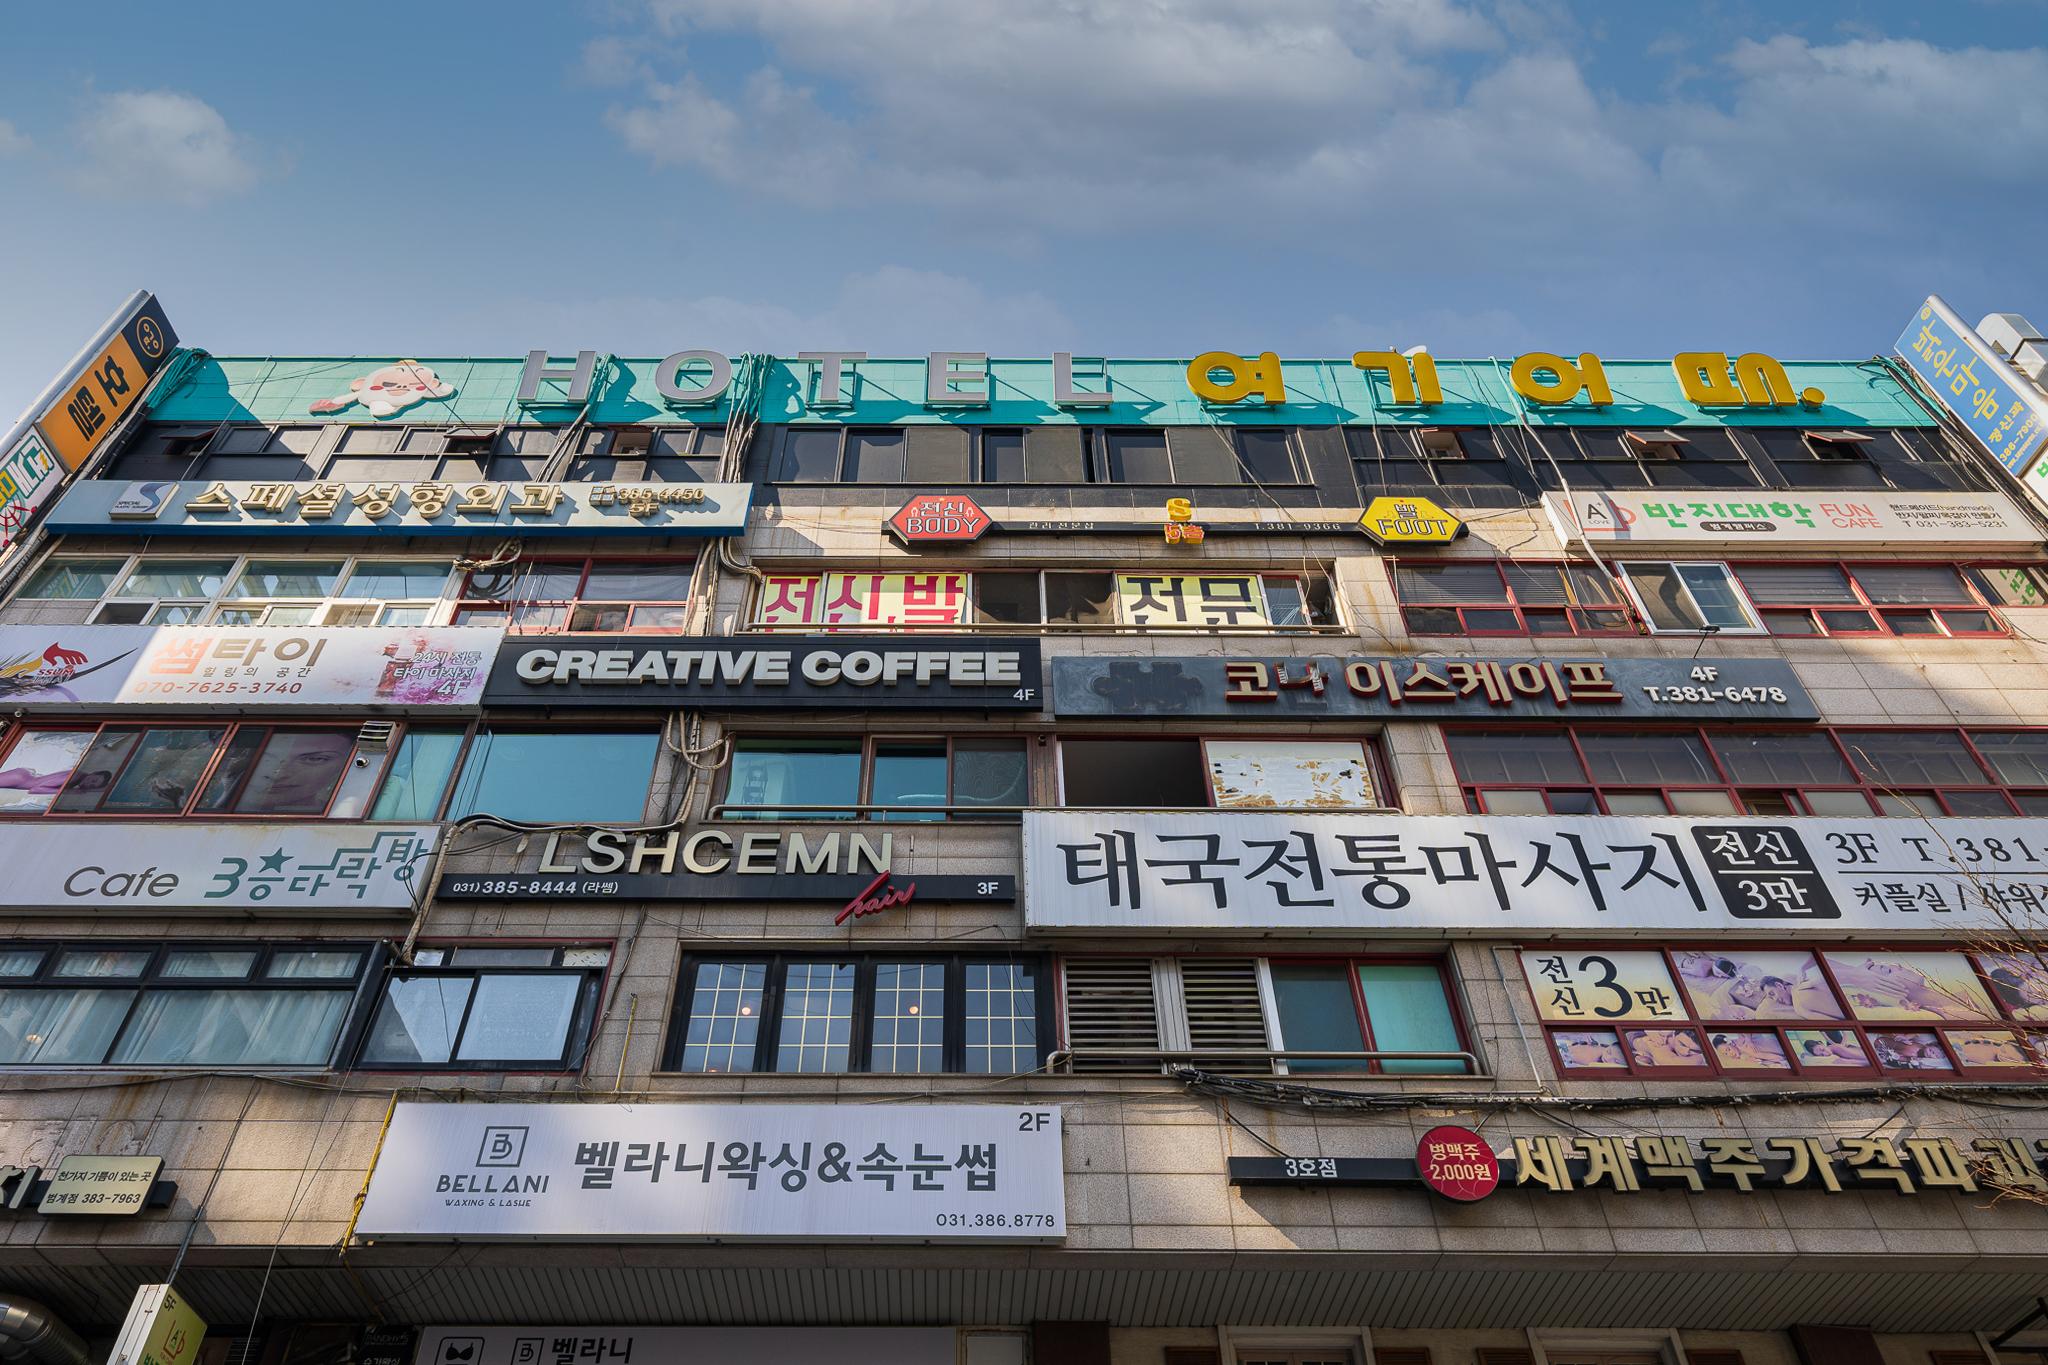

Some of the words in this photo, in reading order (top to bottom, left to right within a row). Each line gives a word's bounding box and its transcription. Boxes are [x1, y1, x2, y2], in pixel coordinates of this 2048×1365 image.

[517, 350, 1114, 404] HOTEL
[67, 355, 130, 442] 호텔
[185, 482, 564, 518] 스페셜성형외과
[919, 501, 966, 517] 전신
[629, 502, 660, 517] 5F
[1394, 504, 1418, 519] 발
[1642, 502, 1816, 528] 반지대학
[1819, 504, 1874, 517] FUN
[906, 517, 981, 533] BODY
[1376, 519, 1448, 535] FOOT
[1832, 518, 1883, 529] CAFE
[150, 638, 327, 674] 썸타이
[393, 667, 427, 679] 타이
[428, 667, 478, 680] 마사지
[515, 649, 791, 686] CREATIVE
[801, 650, 1021, 687] COFFEE
[1690, 666, 1719, 682] 4F
[134, 682, 303, 694] 070-7625-3740
[437, 680, 472, 695] 4F
[1346, 660, 1623, 706] 이스케이프
[1013, 689, 1035, 701] 4F
[1643, 686, 1788, 704] T.381-6478
[537, 830, 893, 875] LSHCEMN
[1706, 830, 1799, 866] 전신
[1825, 833, 1880, 864] 3F
[1056, 829, 1707, 912] 태국전통마사지
[64, 866, 179, 897] Cafe
[977, 881, 999, 895] 3F
[1738, 876, 1813, 914] 3만
[1853, 882, 1951, 913] 커플실
[1018, 1113, 1051, 1132] 2F
[1429, 1144, 1481, 1160] 병맥주
[574, 1140, 997, 1193] 벨라니왁싱&속눈썹
[1286, 1158, 1338, 1178] 3호점
[1430, 1164, 1492, 1180] 2,000원
[57, 1171, 88, 1182] 천가지
[119, 1172, 139, 1182] 있는
[141, 1171, 152, 1182] 곳
[436, 1174, 549, 1193] BELLANI
[46, 1194, 79, 1204] 범계점
[82, 1193, 141, 1204] 383-7963
[936, 1213, 1056, 1228] 031.386.8778
